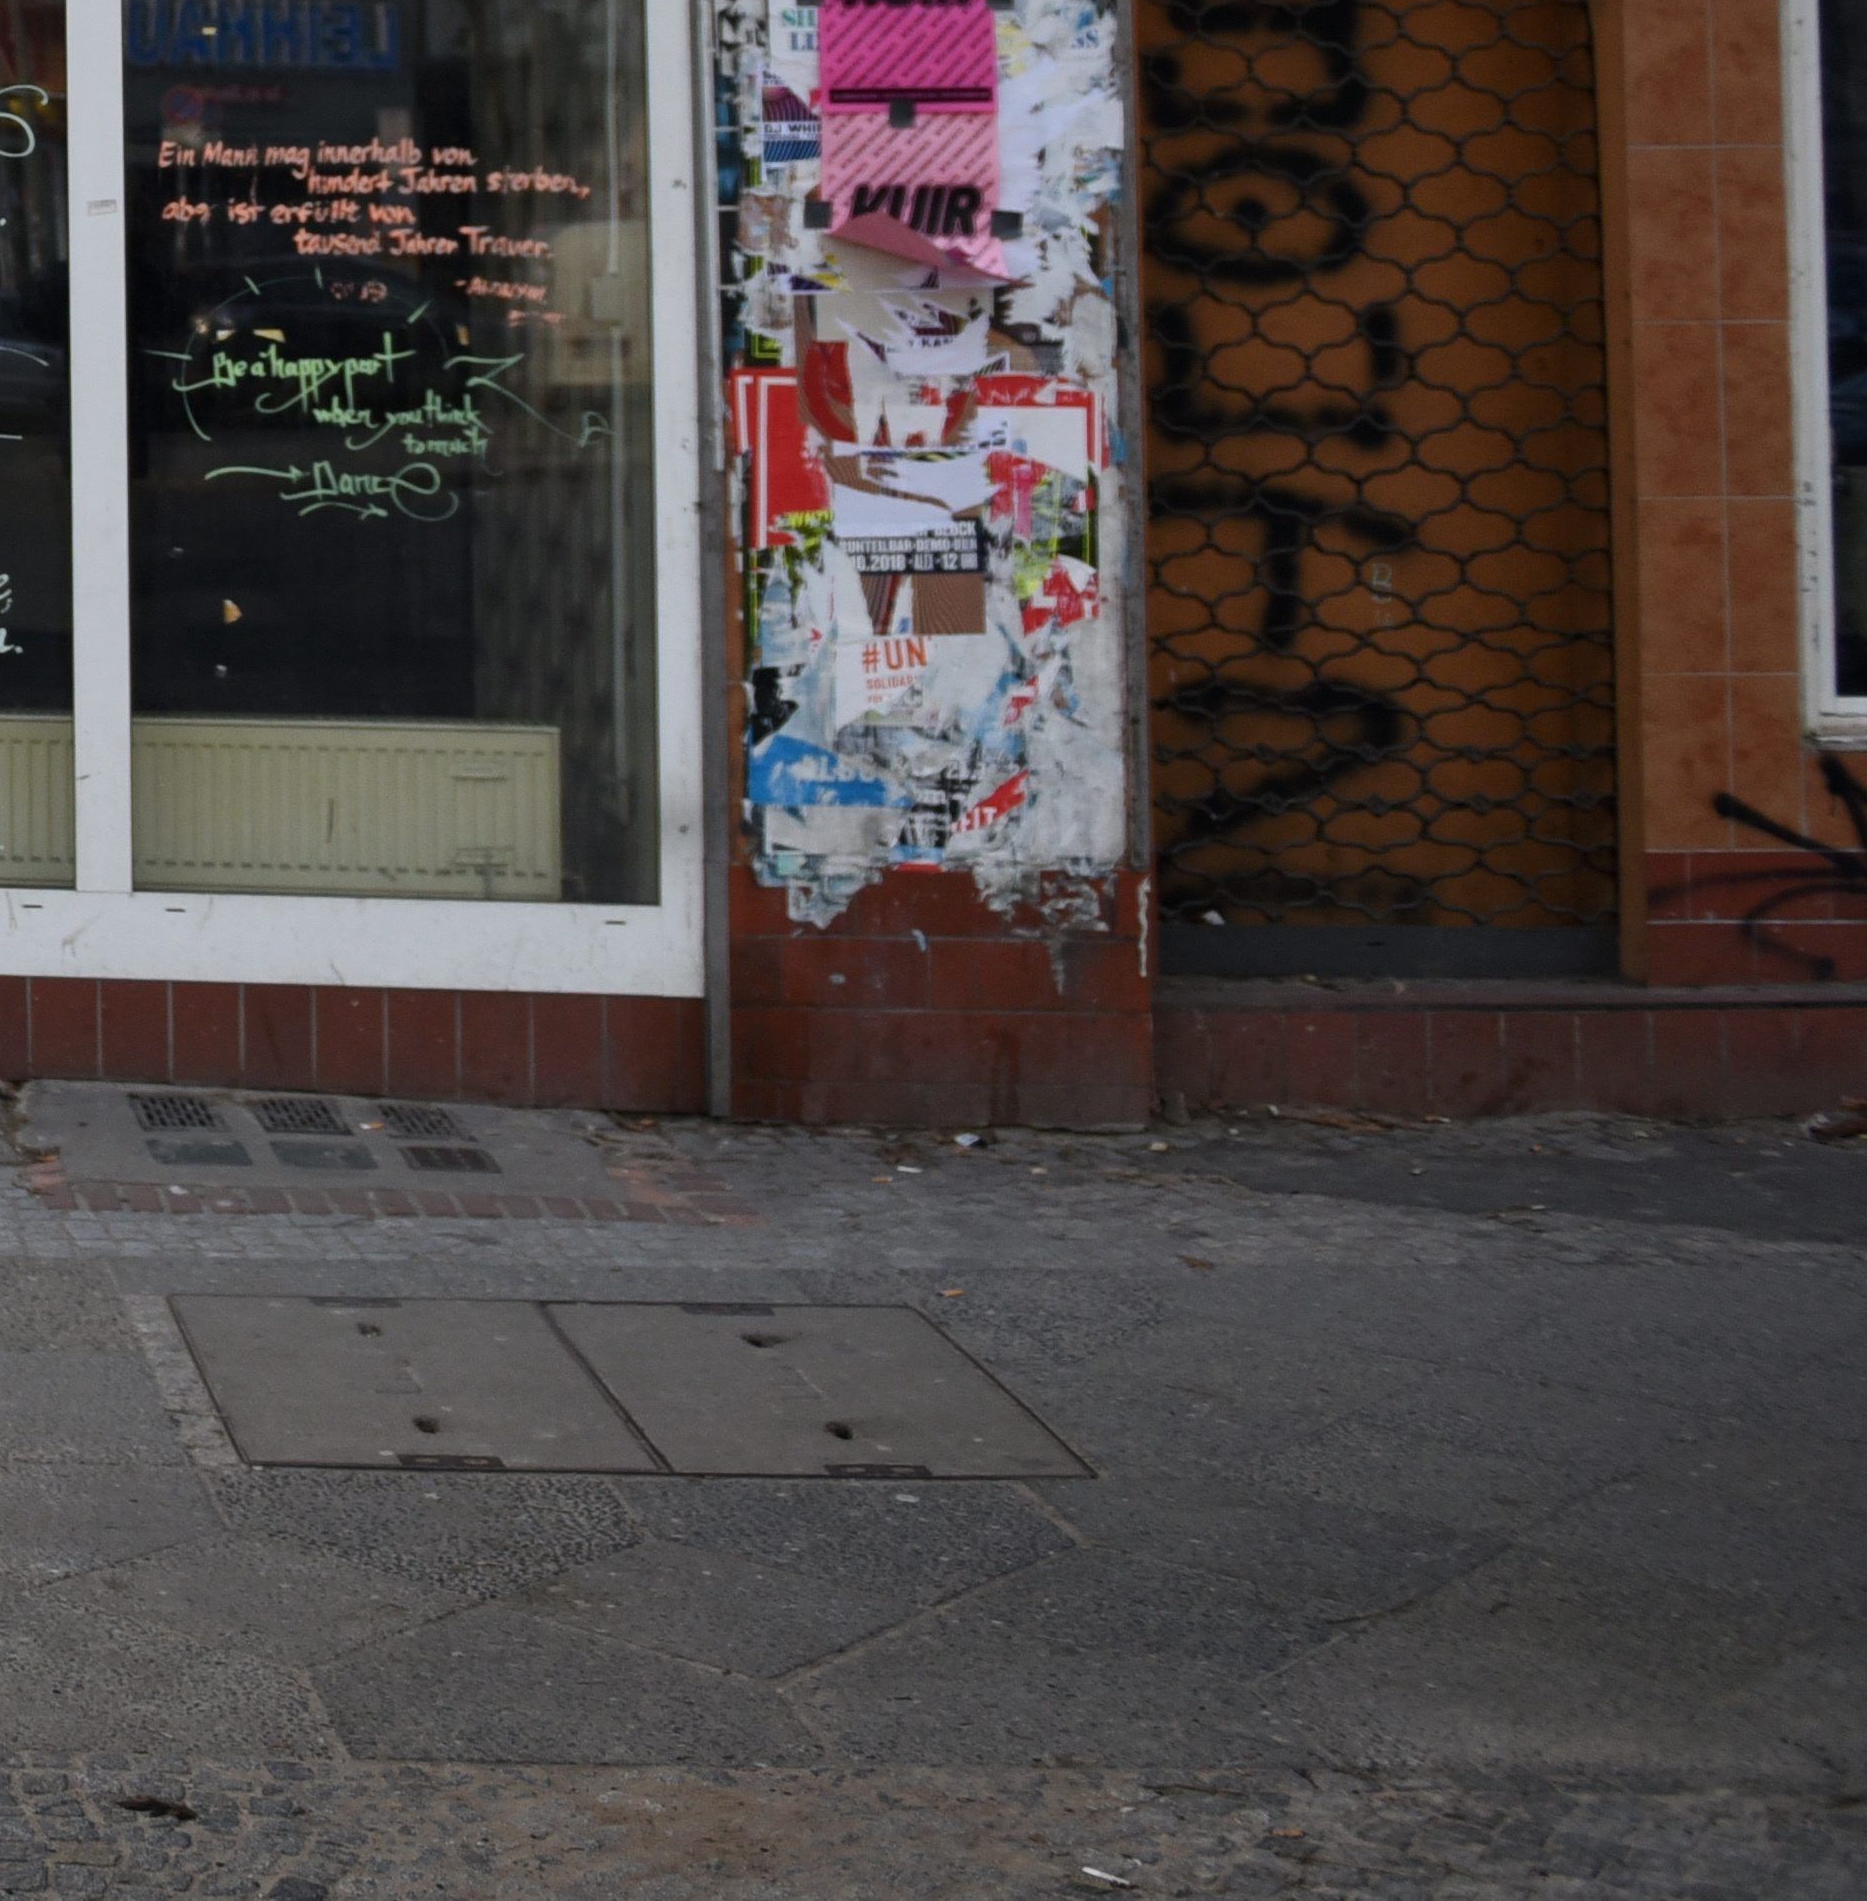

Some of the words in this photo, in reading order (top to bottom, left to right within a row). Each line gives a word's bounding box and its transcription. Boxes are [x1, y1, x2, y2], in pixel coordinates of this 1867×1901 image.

[158, 140, 196, 168] Ein
[203, 141, 259, 167] Mann
[265, 145, 311, 179] mag
[318, 136, 423, 165] innerhalb
[431, 145, 479, 166] von
[398, 166, 478, 195] Jahren
[228, 197, 267, 225] ist
[368, 202, 417, 224] von
[293, 227, 382, 255] tausend
[313, 395, 379, 429] when
